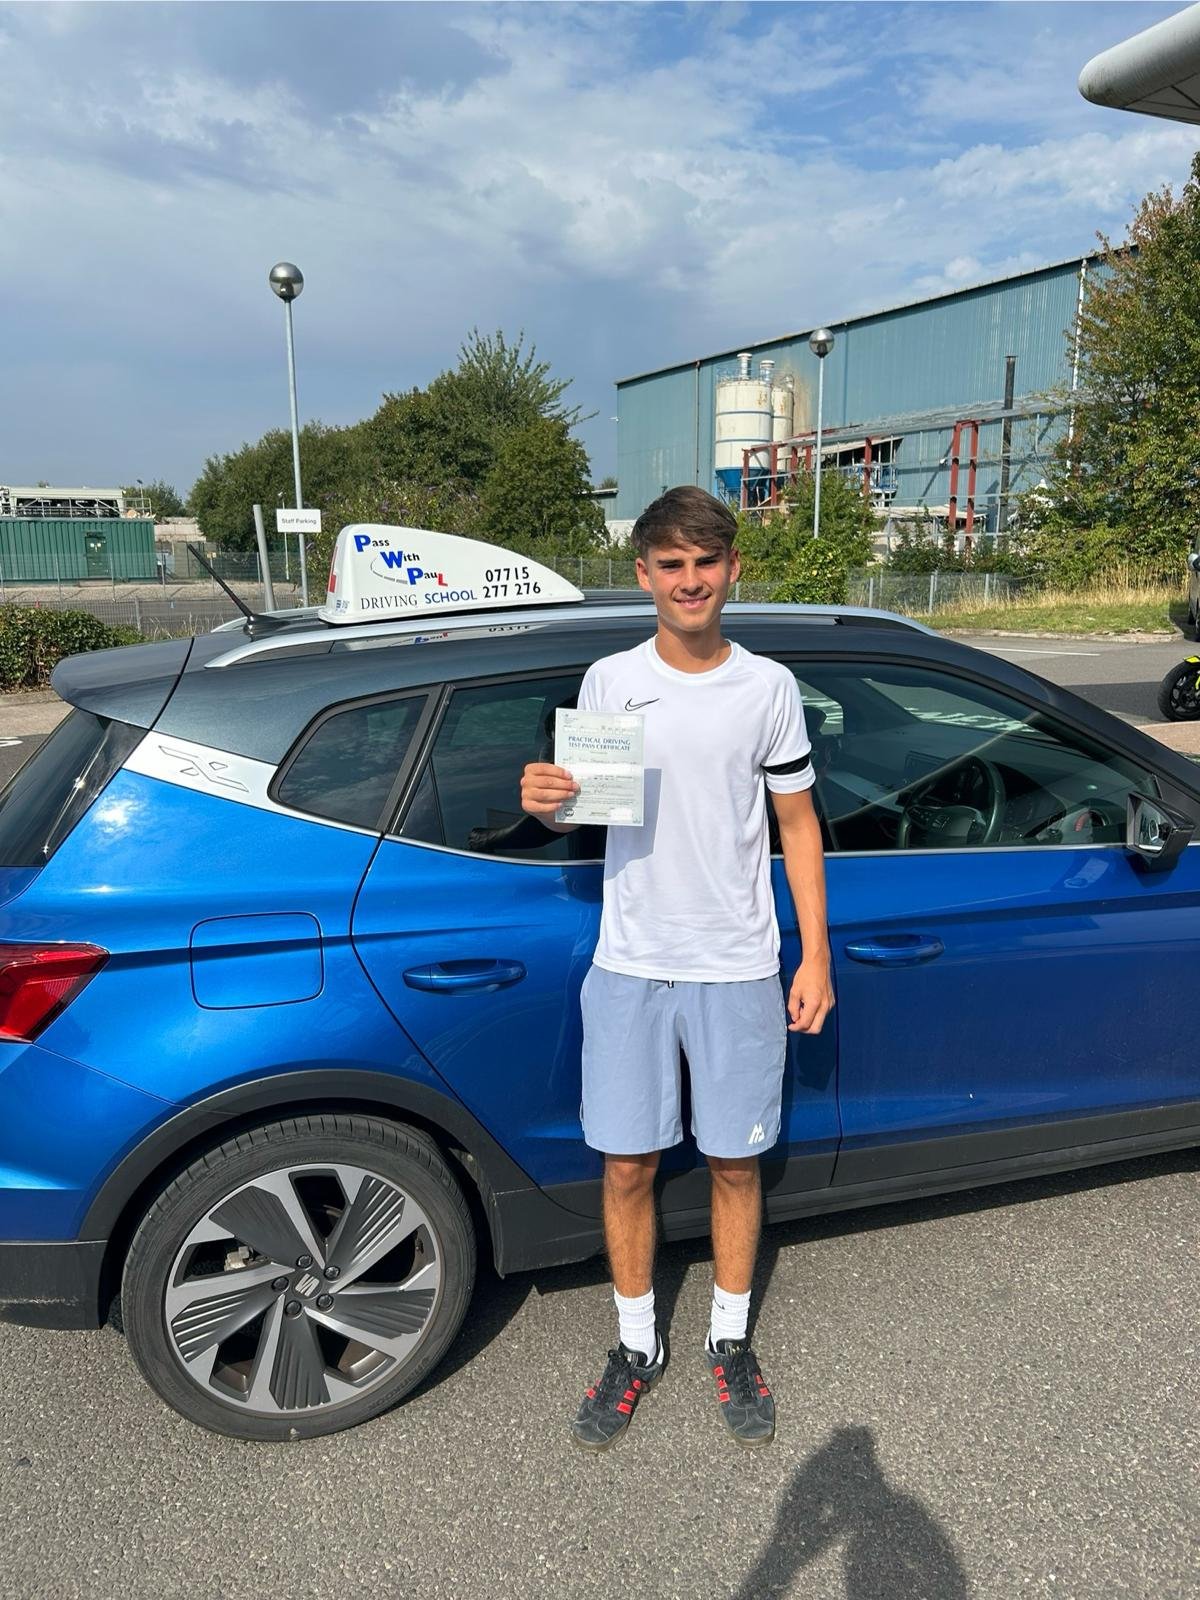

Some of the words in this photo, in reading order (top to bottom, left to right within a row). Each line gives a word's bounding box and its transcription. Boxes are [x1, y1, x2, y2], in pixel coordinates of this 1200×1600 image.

[353, 534, 390, 552] Pass
[380, 550, 420, 568] With
[485, 566, 530, 582] 07715
[482, 584, 508, 598] 277
[514, 581, 541, 595] 276
[360, 594, 418, 610] DRIVING
[424, 590, 477, 604] SCHOOL
[568, 736, 601, 744] PRACTICAL
[603, 737, 631, 745] DRIVING
[596, 743, 630, 751] CERTIFICATE
